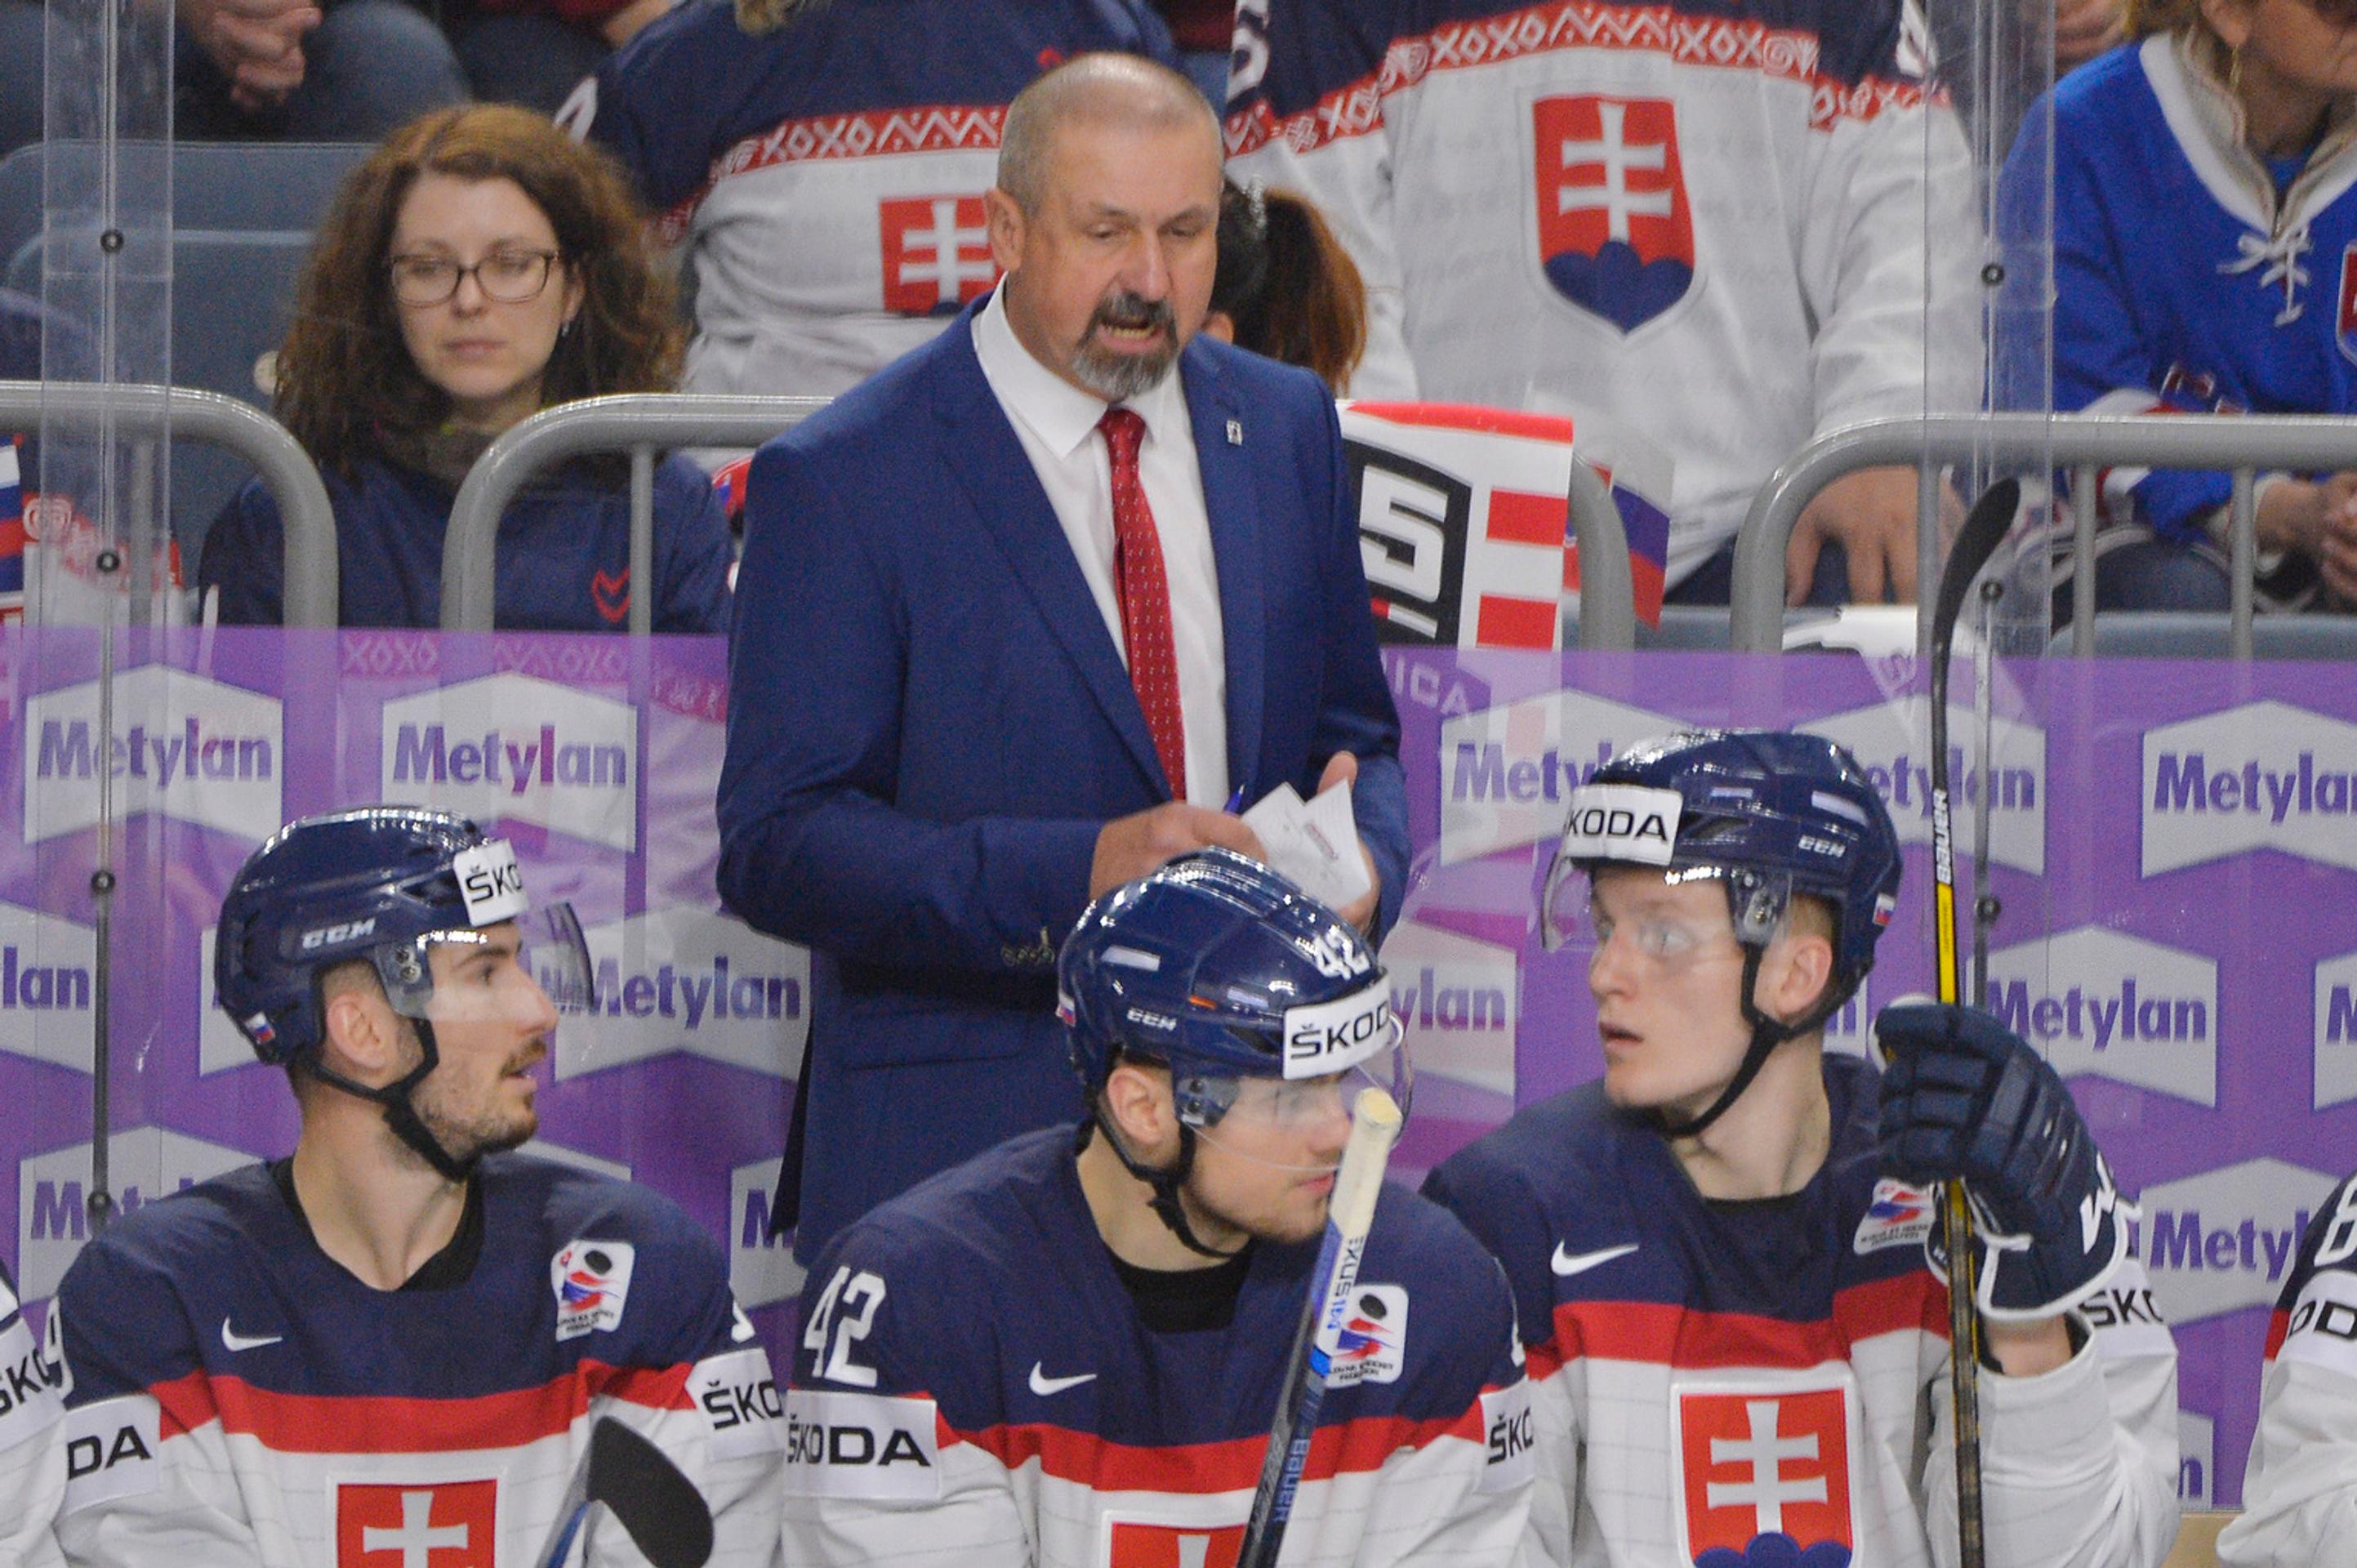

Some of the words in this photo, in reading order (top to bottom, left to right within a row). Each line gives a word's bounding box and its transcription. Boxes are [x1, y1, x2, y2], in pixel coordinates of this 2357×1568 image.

[37, 718, 272, 788] Metylan
[392, 724, 626, 794] Metylan
[2154, 751, 2357, 824] Metyla
[302, 917, 376, 949] CCM
[1315, 924, 1371, 980] 42
[2, 946, 91, 1010] lan
[1986, 978, 2207, 1052] Metylan
[803, 1265, 886, 1388] 42
[67, 1425, 153, 1481] DA
[787, 1413, 931, 1467] ŠKODA
